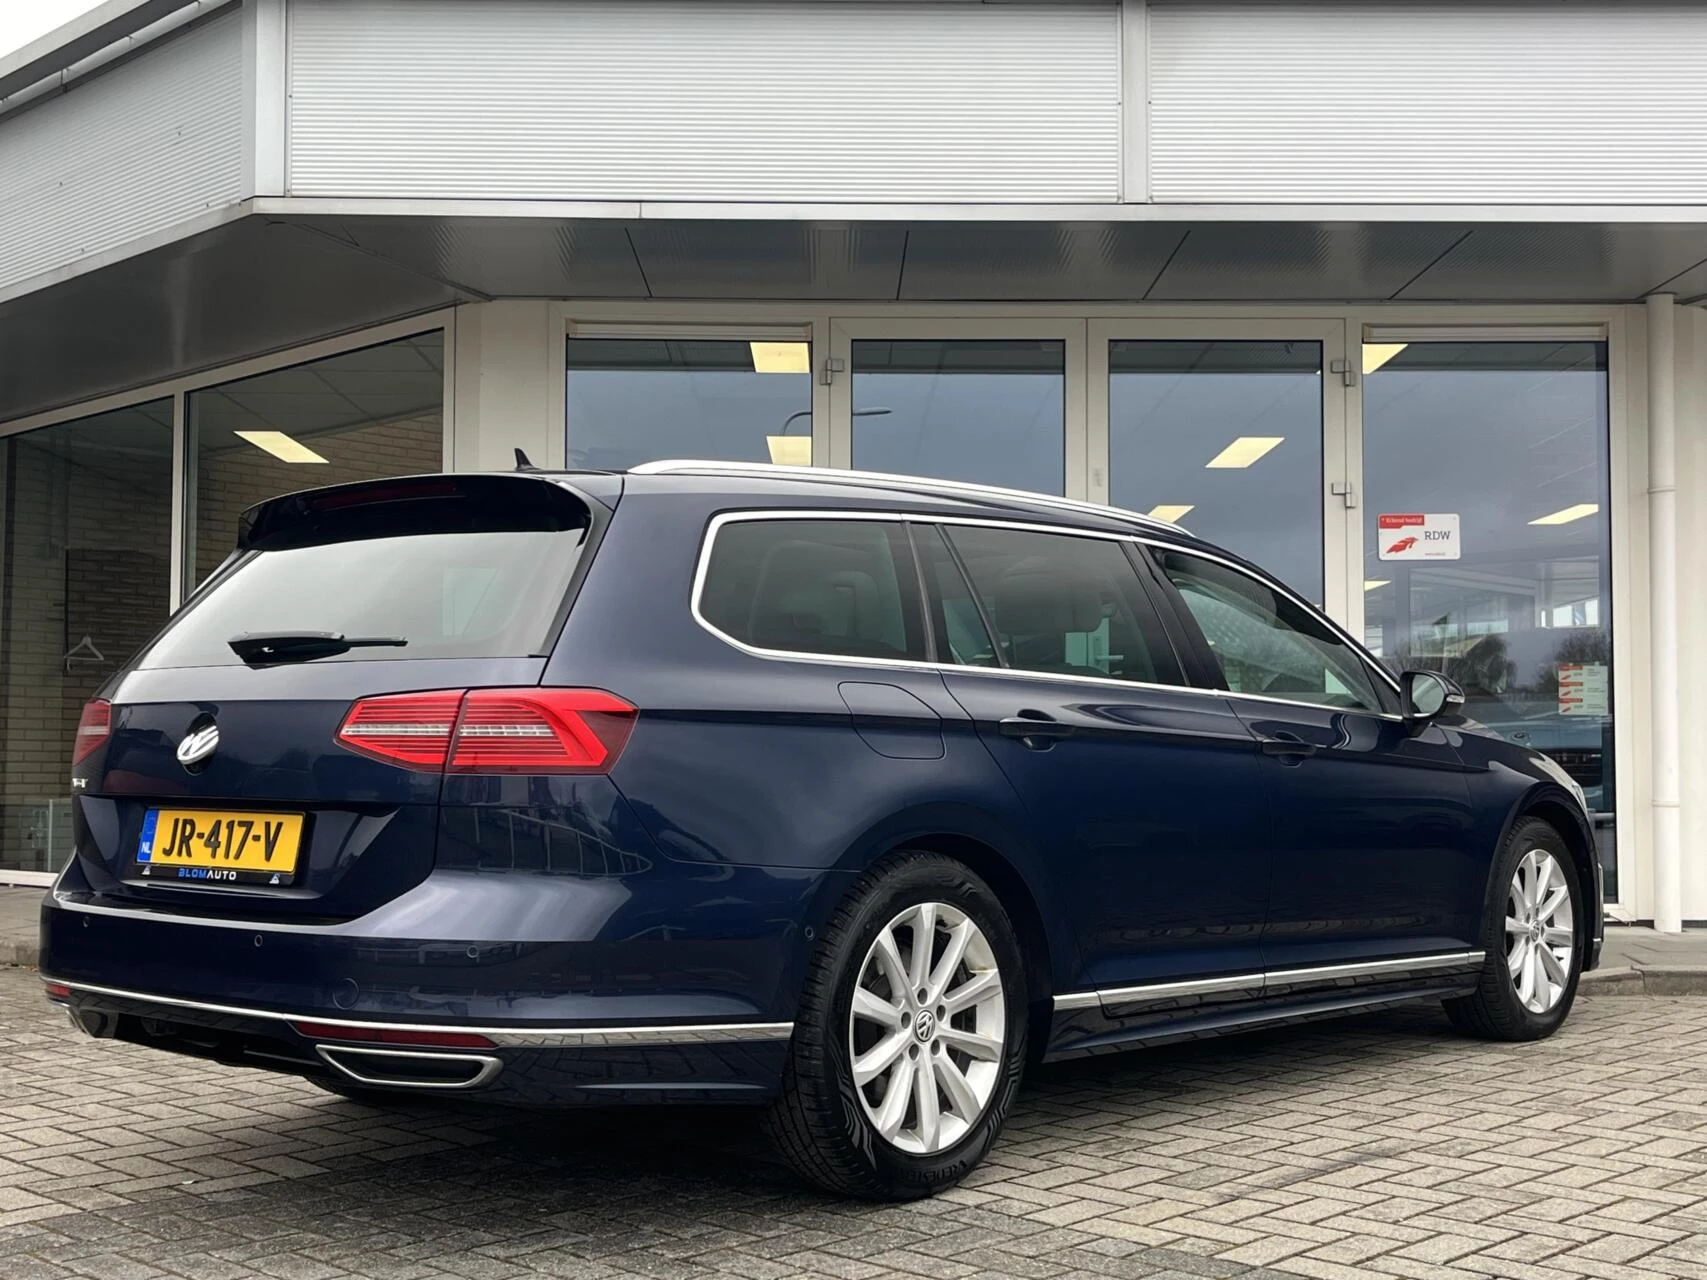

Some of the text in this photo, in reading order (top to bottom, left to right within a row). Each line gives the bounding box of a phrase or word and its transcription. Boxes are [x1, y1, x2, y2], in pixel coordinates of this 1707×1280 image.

[1424, 530, 1451, 540] RDW
[162, 817, 284, 862] JR-417-V
[141, 841, 151, 854] NL
[178, 867, 237, 881] BLOMAUTO
